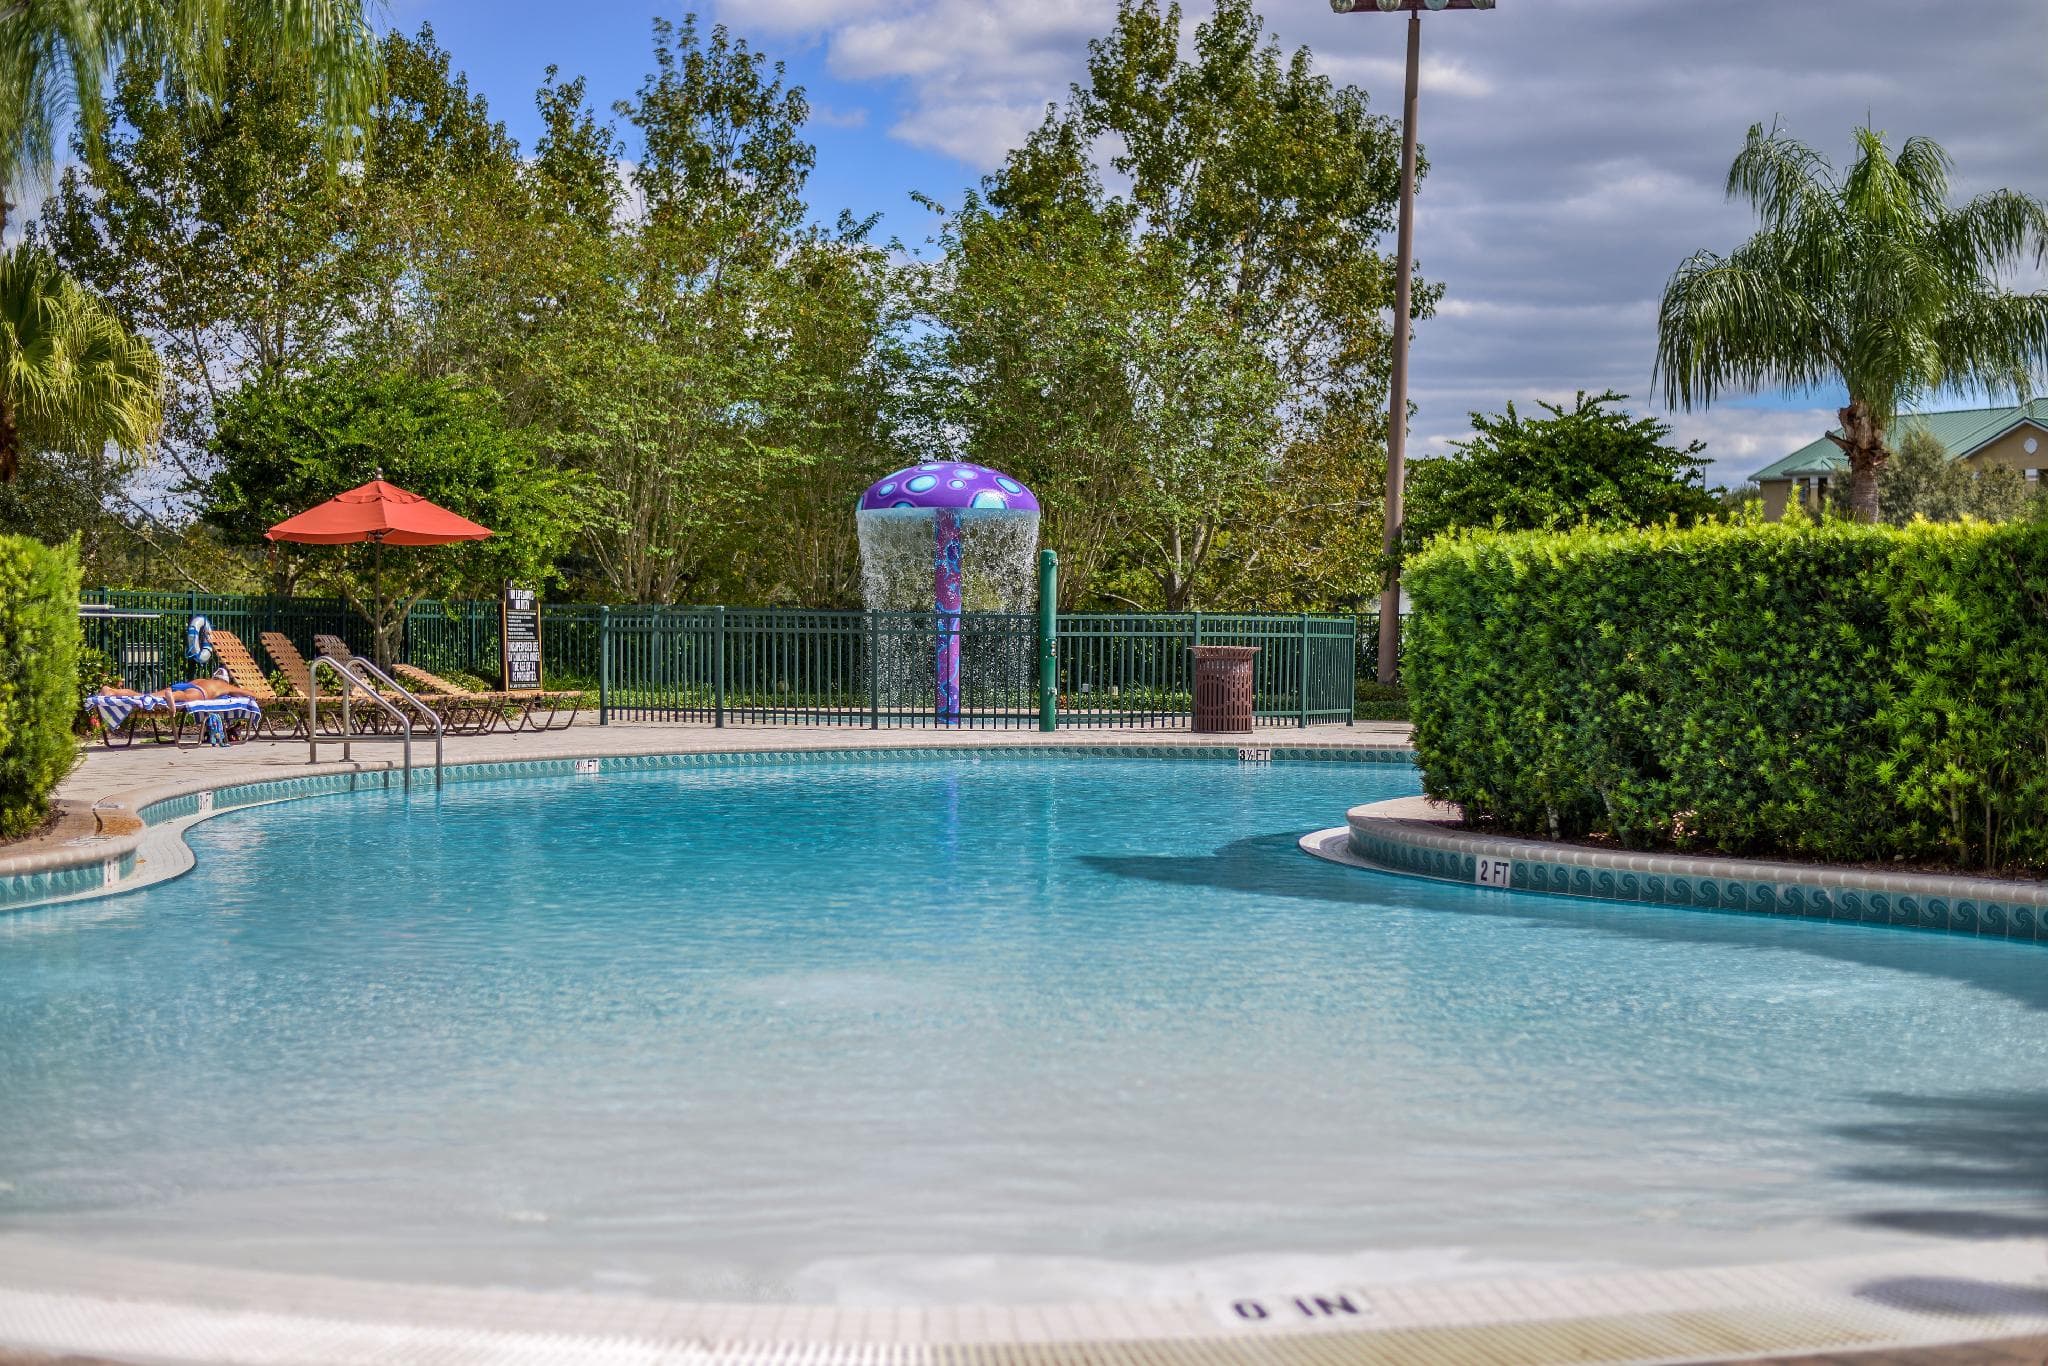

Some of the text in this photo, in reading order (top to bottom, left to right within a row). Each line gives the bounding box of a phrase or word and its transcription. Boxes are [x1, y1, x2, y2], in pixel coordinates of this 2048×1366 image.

[1256, 749, 1269, 761] FT
[588, 759, 598, 771] FT
[1480, 859, 1509, 884] 2 FT
[1294, 1296, 1359, 1316] IN
